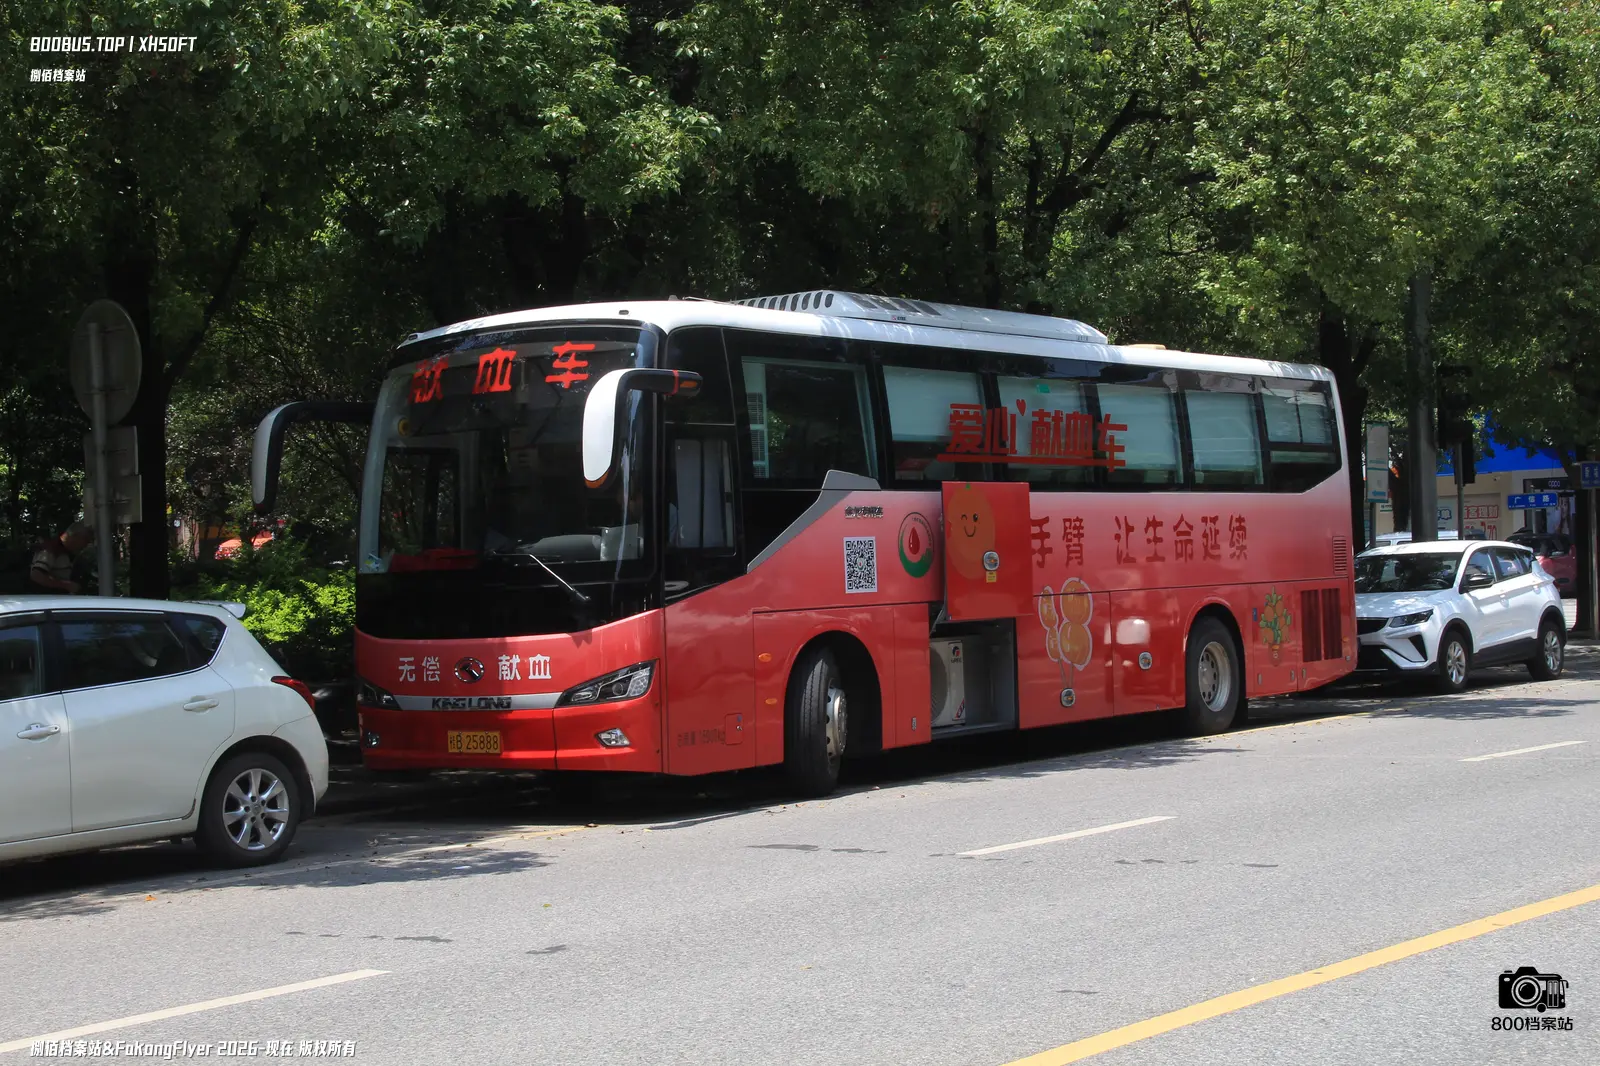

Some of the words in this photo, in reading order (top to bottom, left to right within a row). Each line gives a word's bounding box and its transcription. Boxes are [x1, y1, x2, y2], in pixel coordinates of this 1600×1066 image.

[408, 341, 596, 404] 献血车
[944, 402, 1128, 473] 爱心献血车
[1114, 513, 1248, 565] 让生命延续
[398, 655, 441, 682] 无偿
[497, 653, 552, 681] 献血
